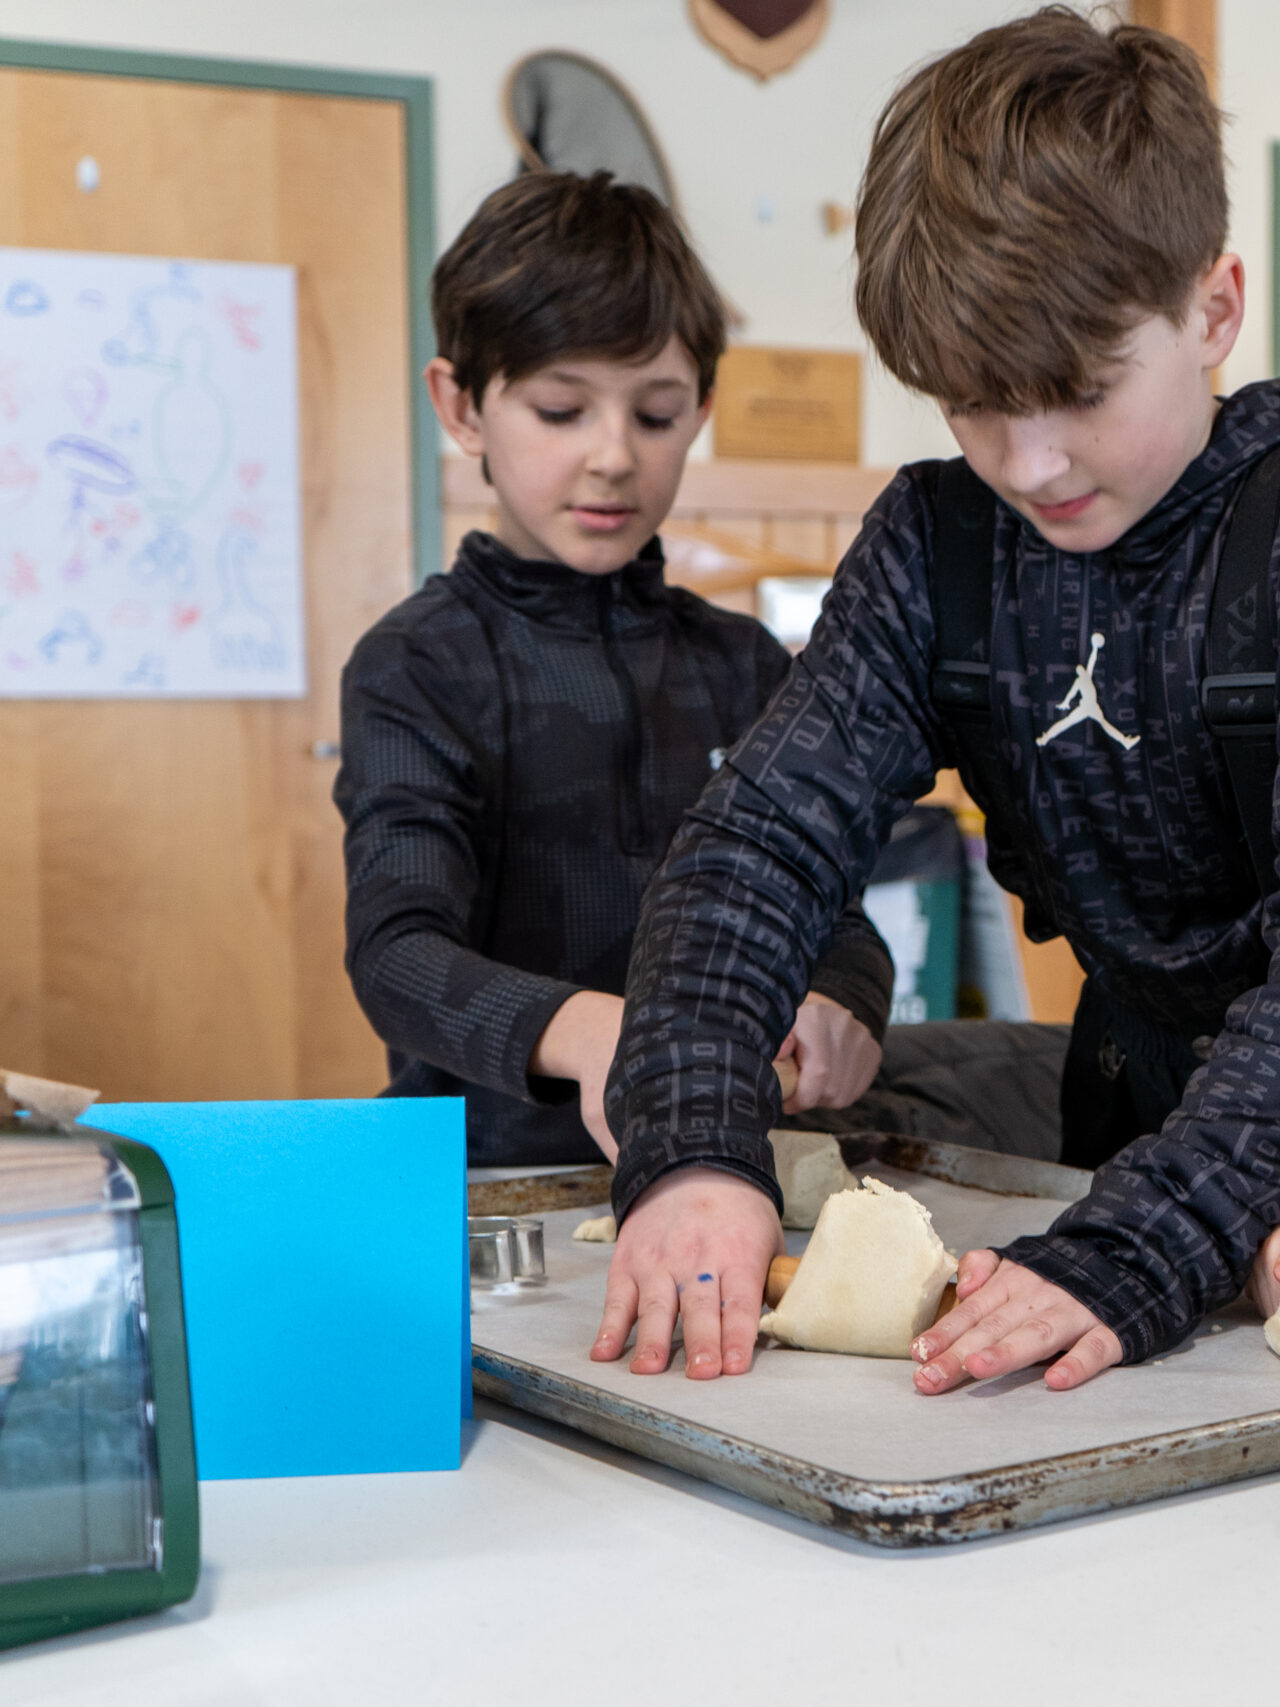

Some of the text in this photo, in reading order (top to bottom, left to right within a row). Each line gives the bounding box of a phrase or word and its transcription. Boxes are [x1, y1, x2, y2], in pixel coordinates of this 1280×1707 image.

[1060, 559, 1079, 650] ORING
[751, 678, 808, 752] OOKIE
[1145, 718, 1178, 803] MVP
[690, 1042, 715, 1127] OOKIE
